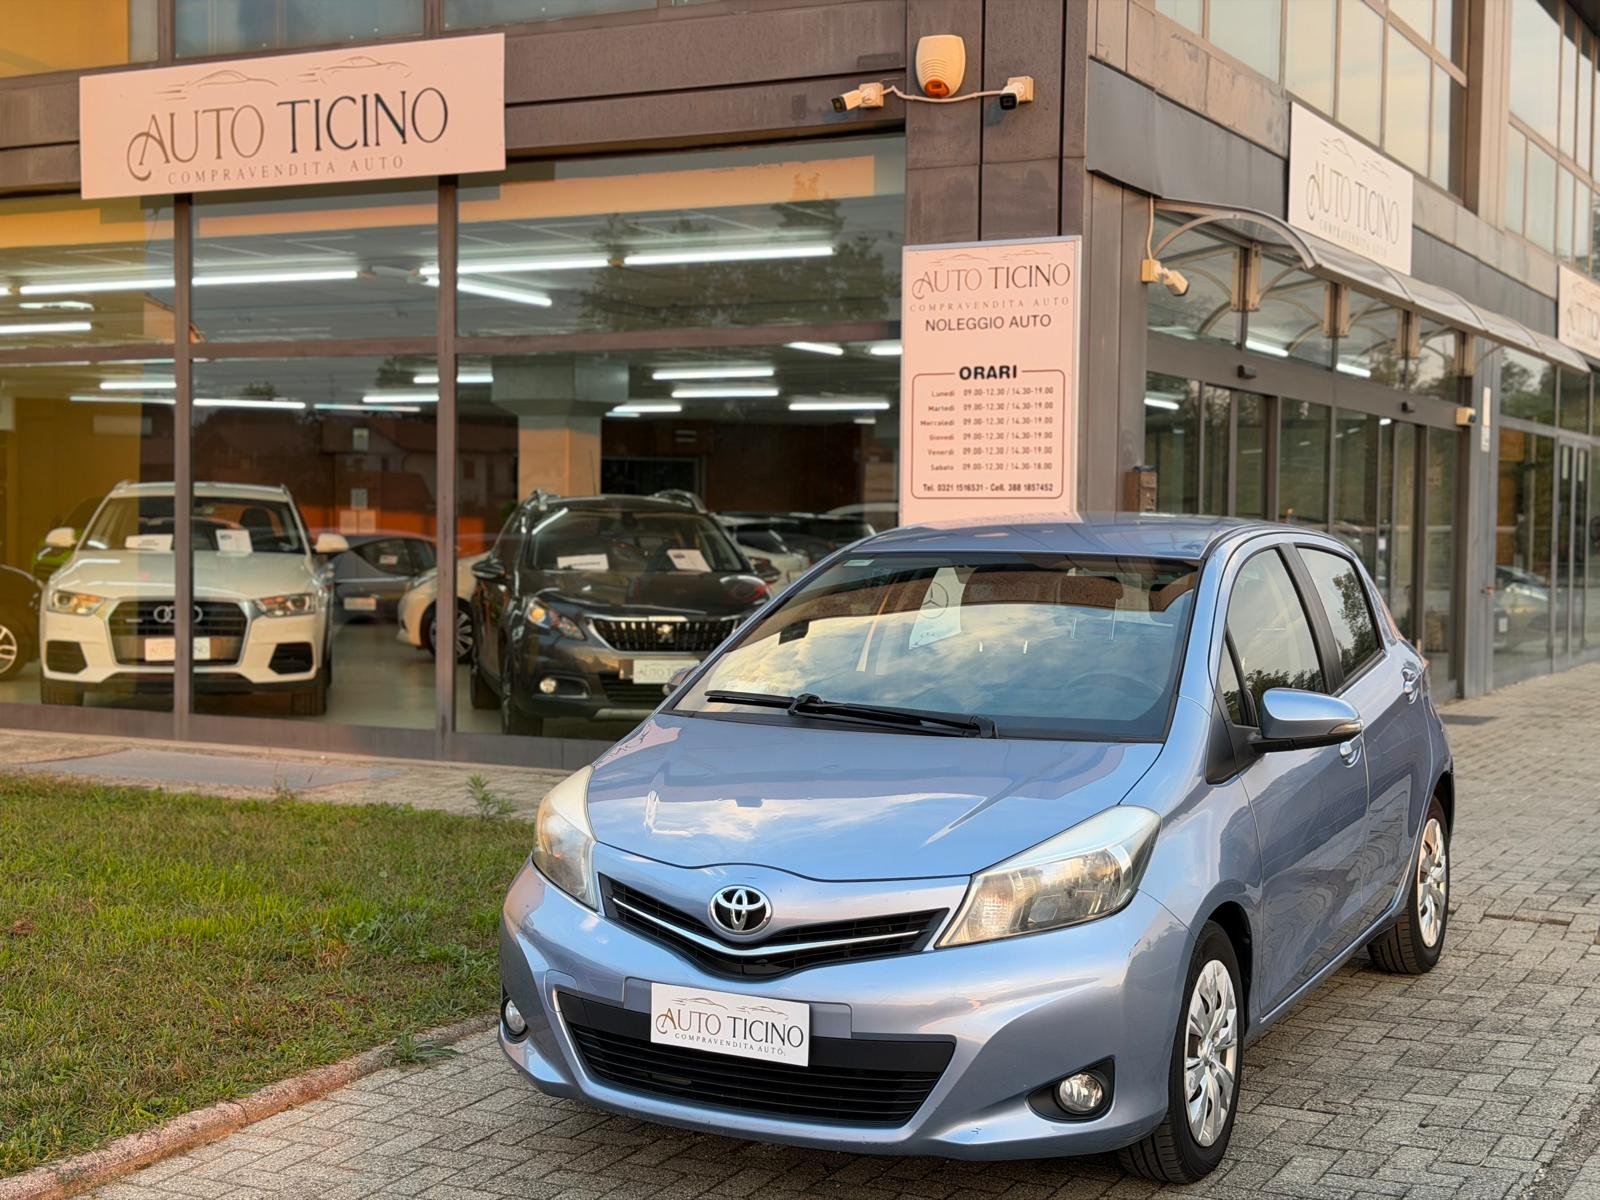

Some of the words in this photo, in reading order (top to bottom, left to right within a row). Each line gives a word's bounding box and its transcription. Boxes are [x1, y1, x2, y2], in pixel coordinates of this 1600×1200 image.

[127, 104, 265, 182] AUTO
[276, 87, 449, 154] TICINO
[168, 161, 336, 185] COMPRAVENDITA
[350, 156, 404, 172] AUTO
[1306, 159, 1352, 223] AUTO
[911, 268, 983, 300] AUTO
[987, 262, 1071, 290] TICINO
[910, 299, 1024, 313] COMPRAVENDITA
[1033, 296, 1069, 307] AUTO
[925, 316, 1004, 332] NOLEGGIO
[1008, 313, 1052, 329] AUTO
[959, 365, 1017, 380] ORARI
[655, 1007, 722, 1035] AUTO
[726, 1015, 804, 1048] TICINO
[674, 1033, 754, 1050] COMPRAVENDITA
